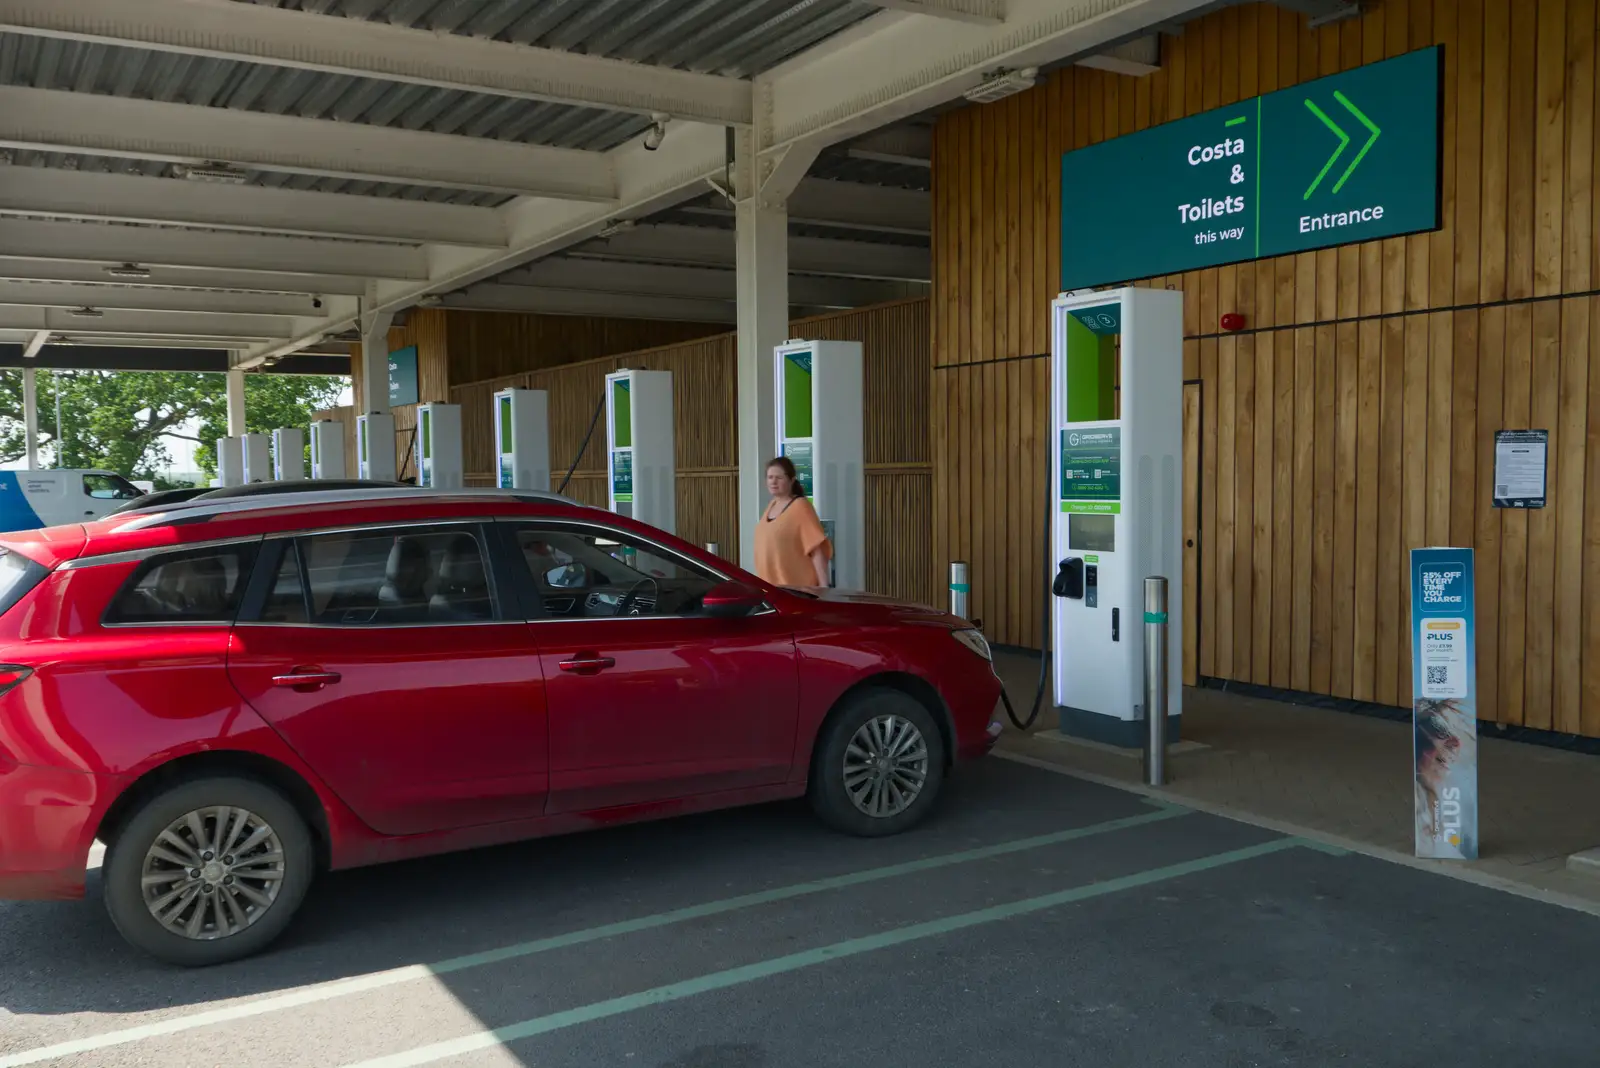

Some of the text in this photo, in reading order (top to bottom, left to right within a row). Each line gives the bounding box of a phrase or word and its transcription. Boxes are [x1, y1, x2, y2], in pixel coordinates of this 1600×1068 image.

[1187, 138, 1245, 166] Costa
[1230, 164, 1245, 185] &
[1178, 195, 1245, 224] Toilets
[1299, 205, 1384, 233] Entrance
[1194, 225, 1245, 245] this way
[1426, 633, 1453, 641] PLUS
[1442, 787, 1461, 845] PLUS
